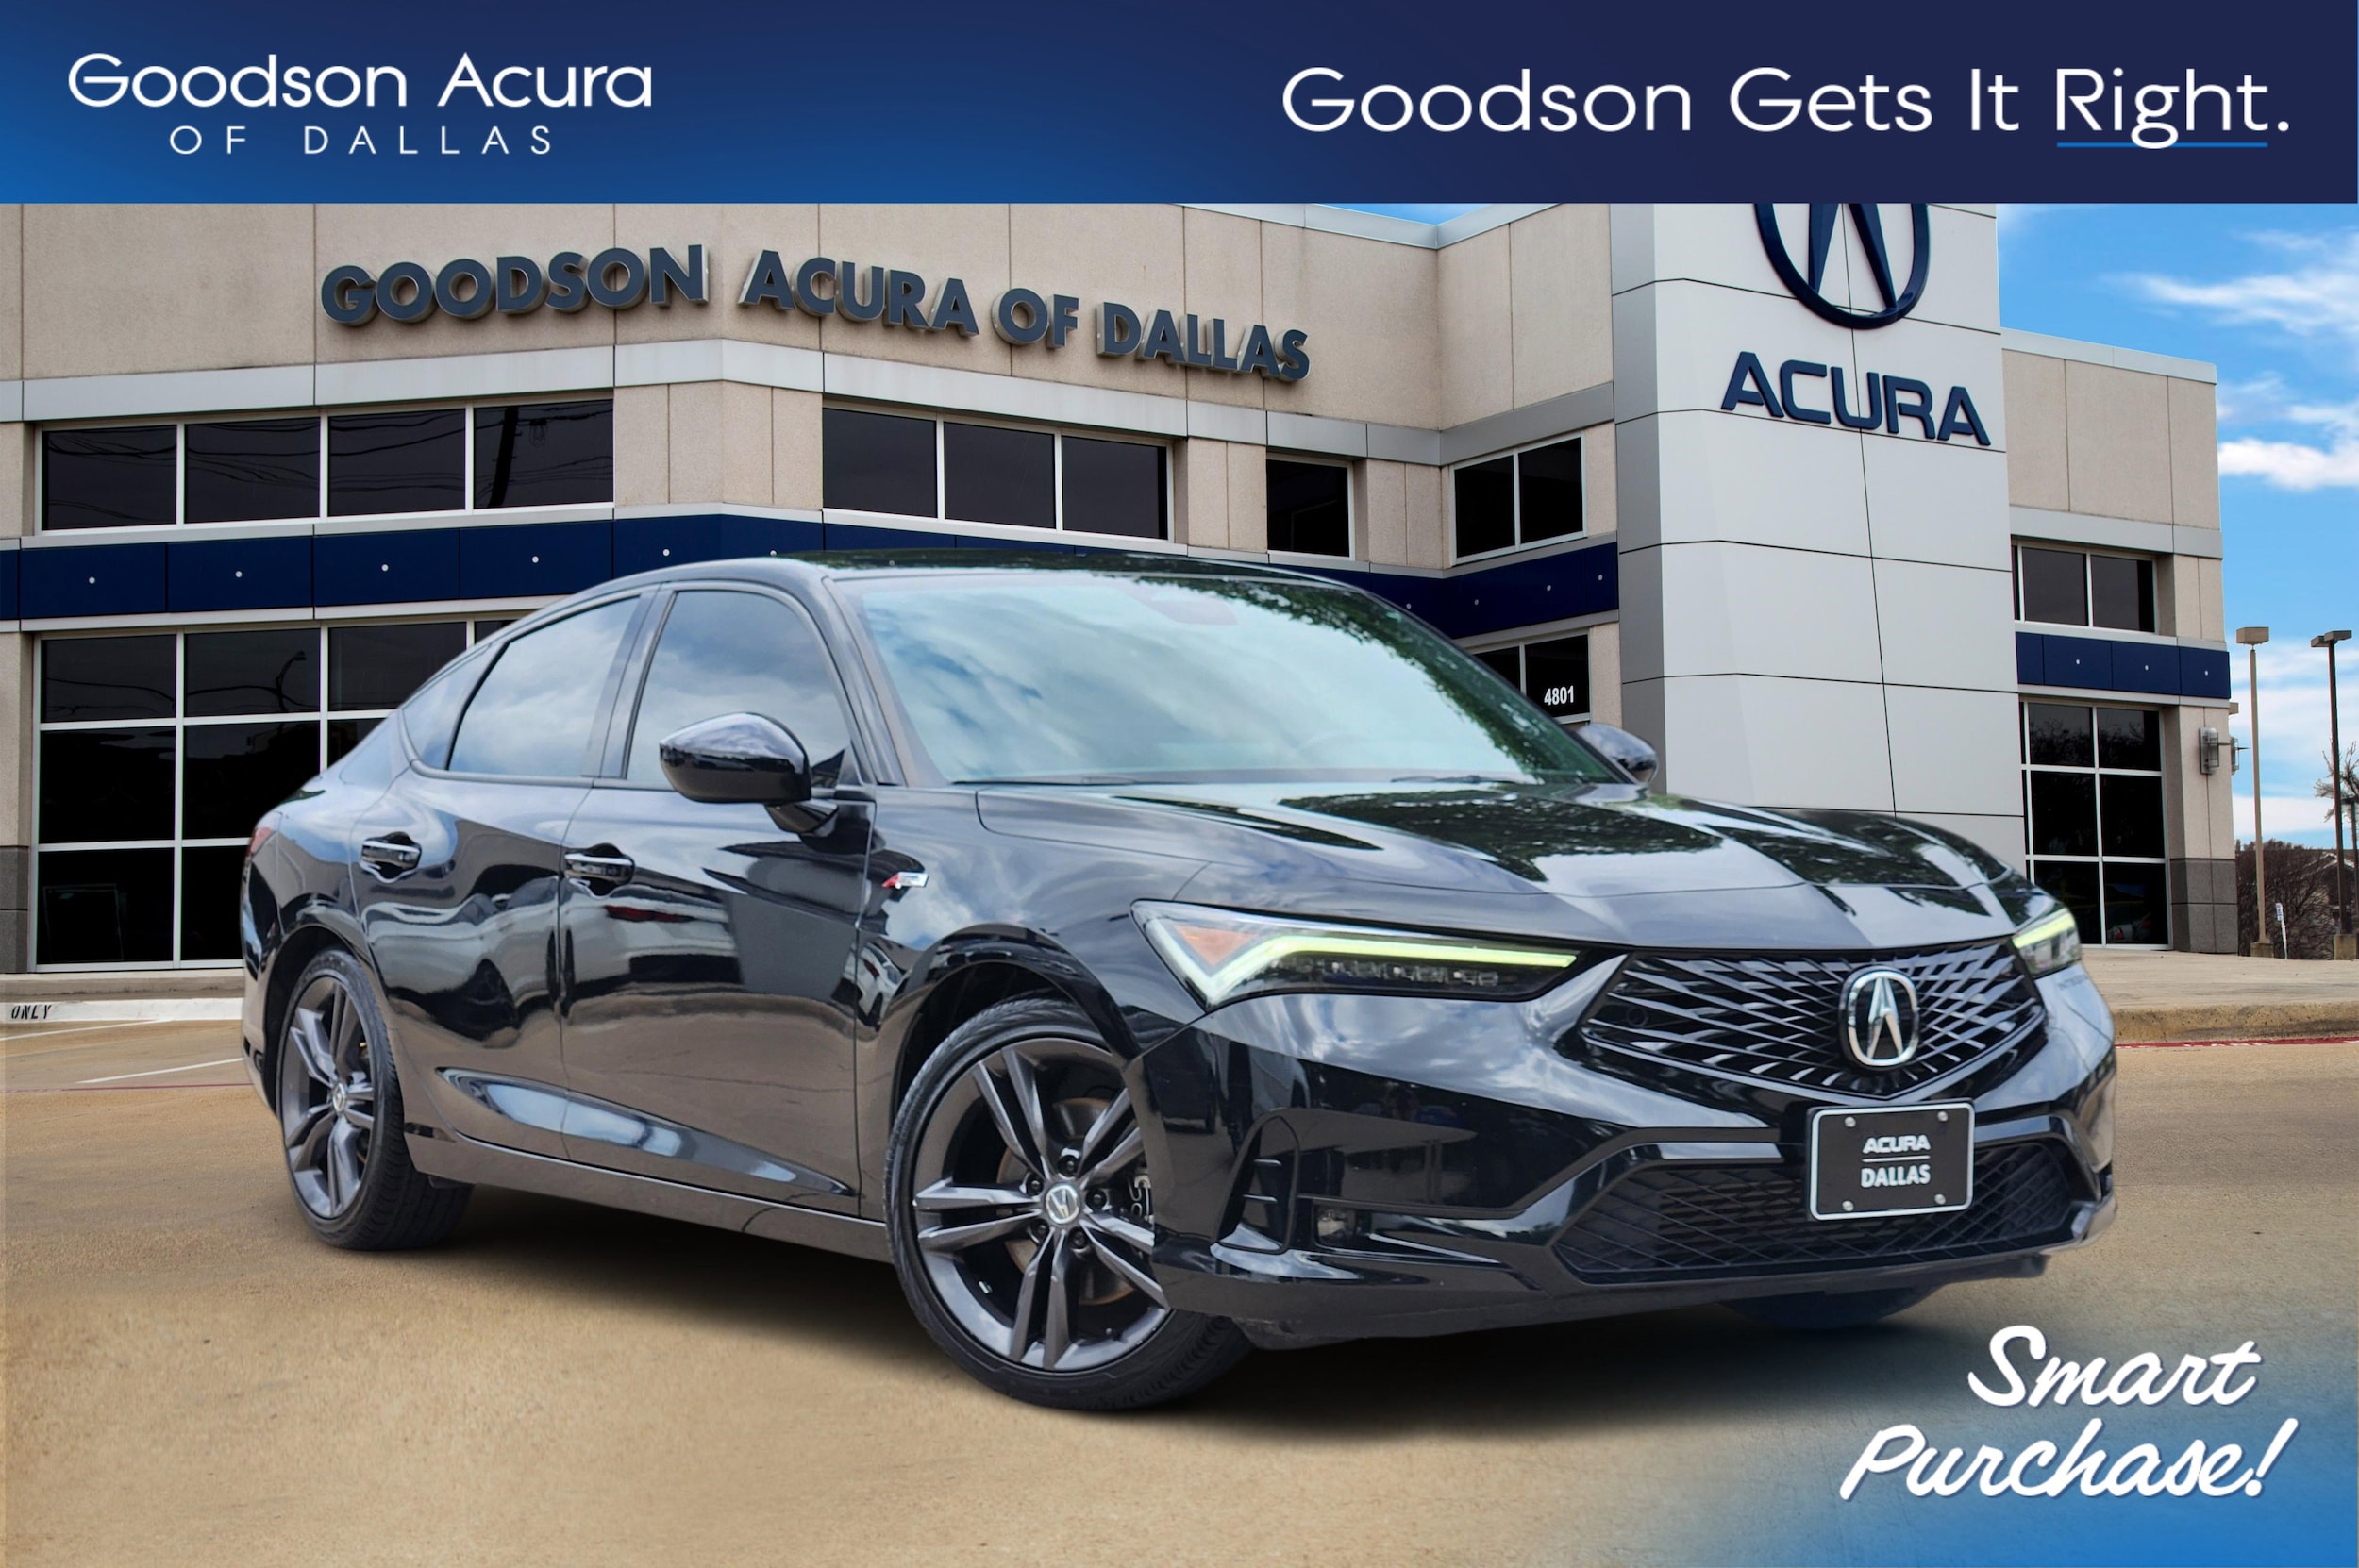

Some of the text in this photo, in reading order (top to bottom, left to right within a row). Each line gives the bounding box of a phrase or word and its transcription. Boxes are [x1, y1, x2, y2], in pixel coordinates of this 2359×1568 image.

[321, 243, 1311, 381] GOODSON ACURA OF DALLAS
[1720, 351, 1991, 447] ACURA
[1544, 685, 1574, 706] 4801
[11, 1004, 52, 1020] ONLY
[1862, 1134, 1932, 1154] ACURA
[1860, 1163, 1932, 1188] DALLAS
